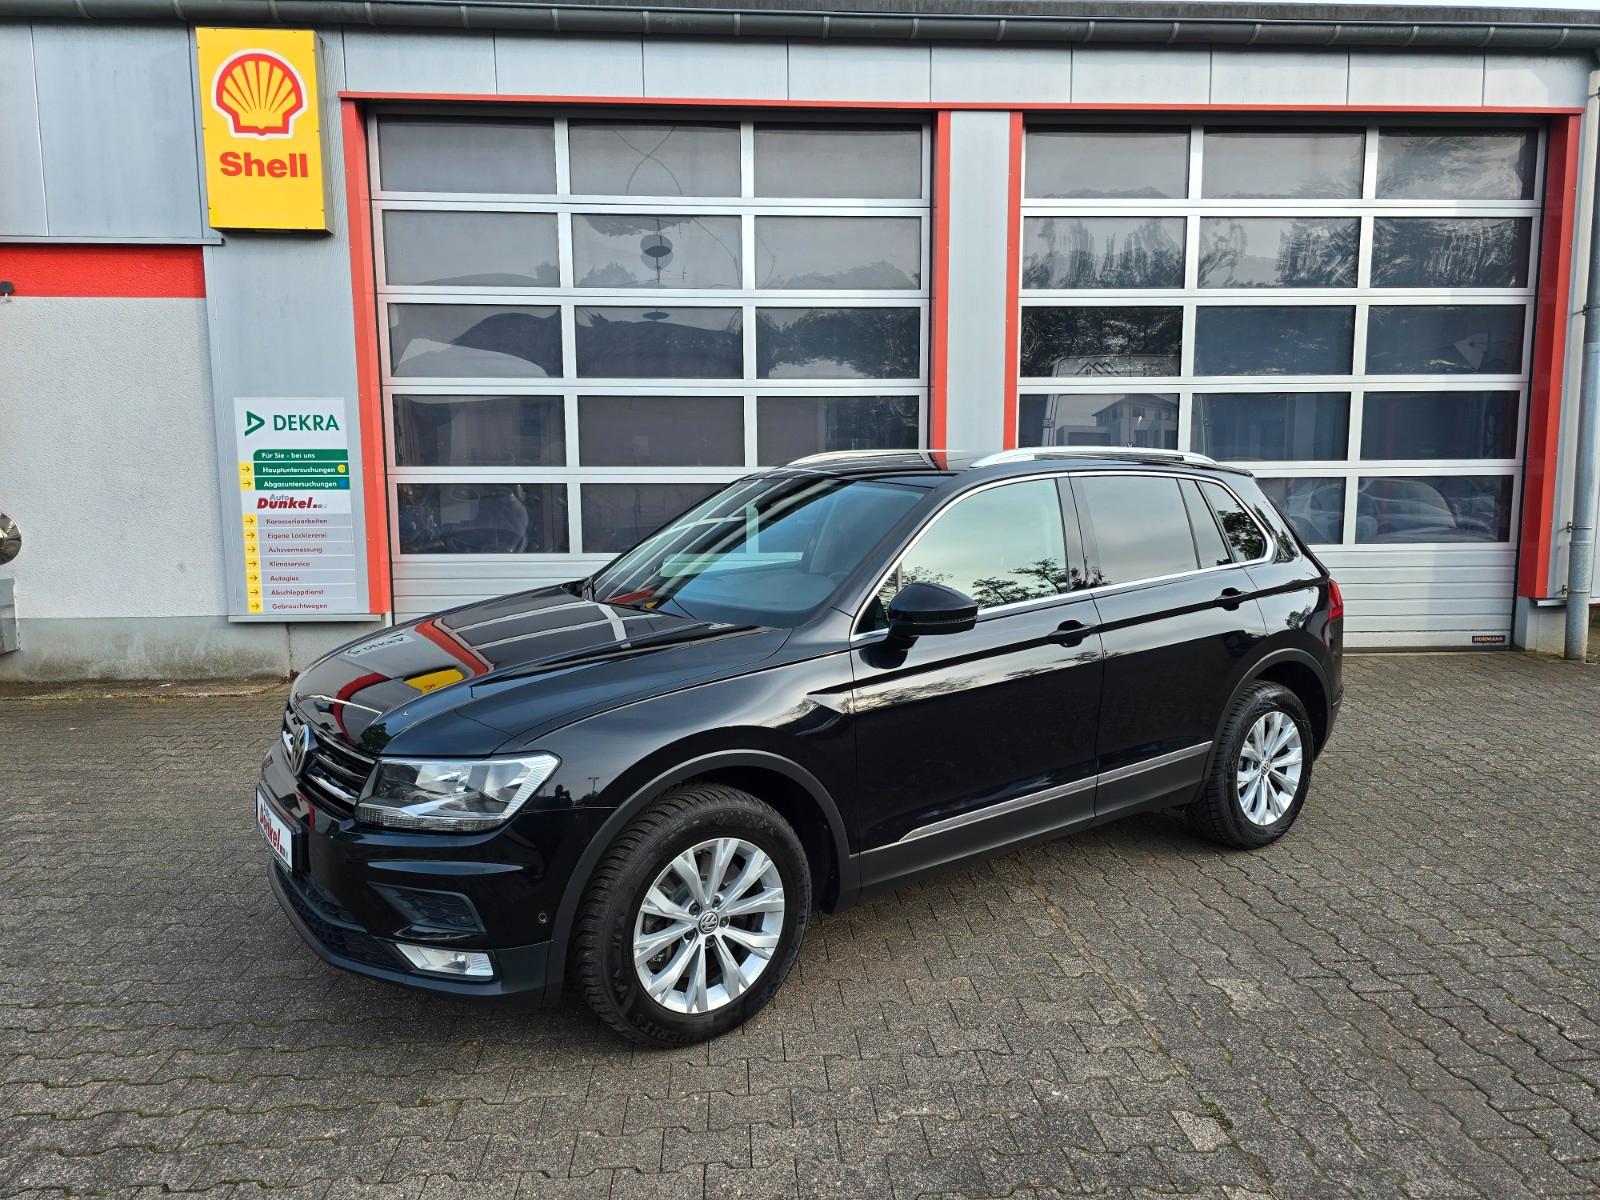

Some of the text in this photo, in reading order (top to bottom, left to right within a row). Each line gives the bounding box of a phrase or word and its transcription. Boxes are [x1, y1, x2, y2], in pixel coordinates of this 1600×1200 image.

[219, 151, 309, 178] Shell
[273, 414, 340, 431] DEKRA
[262, 466, 336, 475] Hauptuntersuchungen
[263, 480, 337, 489] Abgasuntersuchungen
